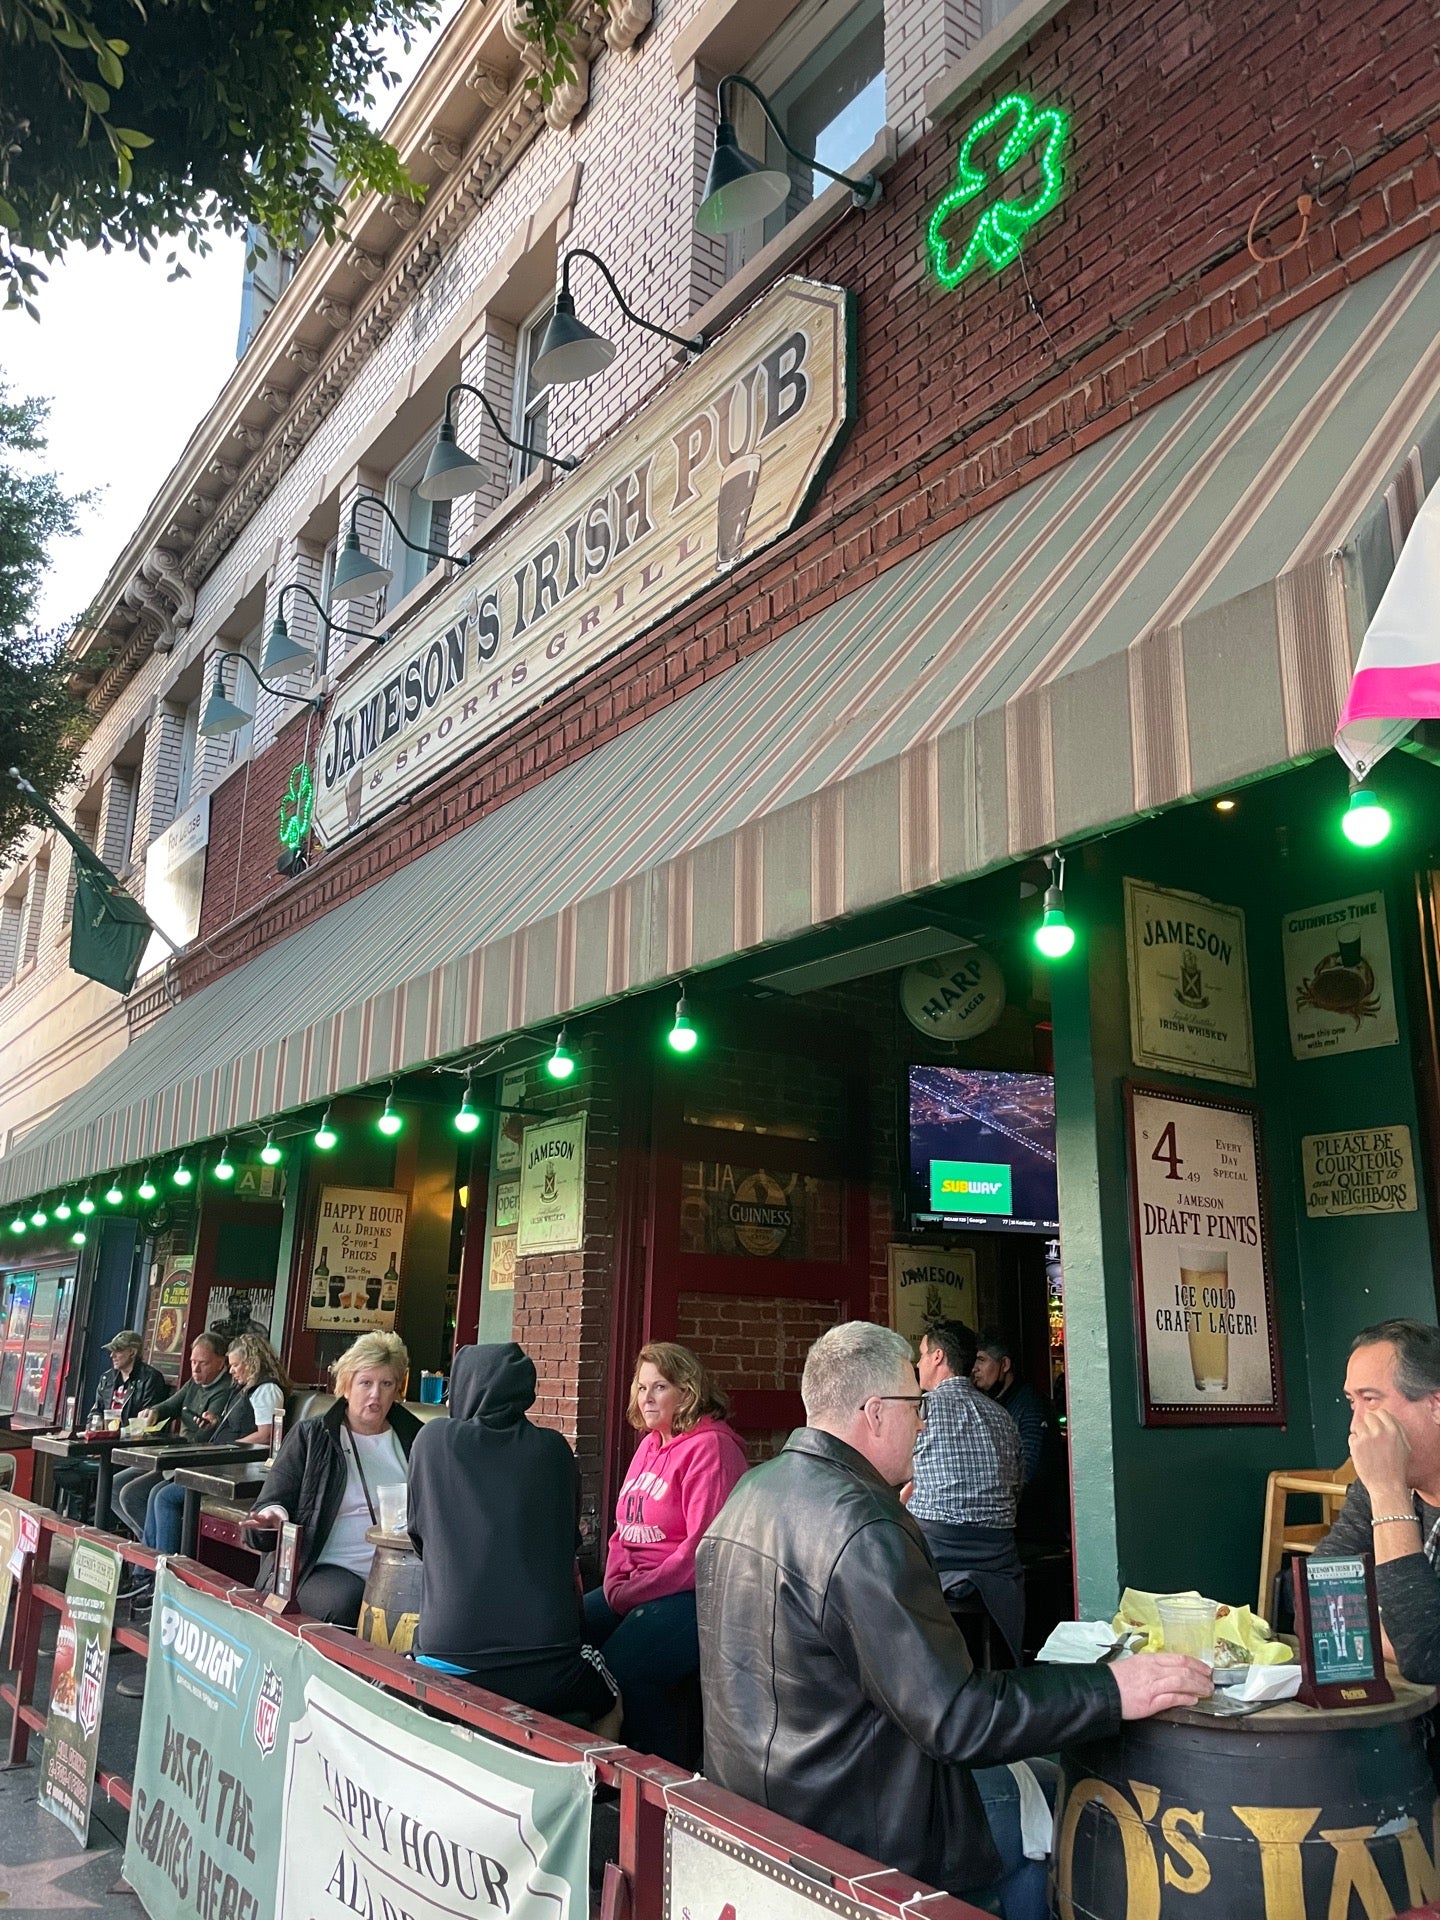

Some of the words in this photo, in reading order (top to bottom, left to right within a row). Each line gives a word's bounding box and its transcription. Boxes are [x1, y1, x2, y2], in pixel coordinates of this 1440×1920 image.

[325, 592, 501, 789] JAMESON'S
[512, 456, 655, 640] IRISH
[671, 332, 808, 515] PUB
[369, 770, 384, 790] &
[396, 659, 529, 772] SPORTS
[545, 534, 704, 661] GRILL
[1289, 908, 1346, 933] GUINNESS
[1348, 902, 1378, 919] TIME
[1143, 920, 1232, 966] JAMESON
[922, 960, 981, 1022] HARP
[959, 993, 986, 1019] LAGER
[1159, 1018, 1185, 1033] IRISH
[1187, 1026, 1228, 1042] WHISKEY
[1316, 1028, 1331, 1038] this
[1307, 1039, 1323, 1049] with
[528, 1141, 575, 1170] JAMESON
[1216, 1139, 1242, 1153] EVERY
[1313, 1135, 1368, 1157] PLEASE
[1373, 1133, 1393, 1152] BE
[1221, 1154, 1238, 1166] DAY
[1316, 1149, 1403, 1175] COURTEOUS
[240, 1171, 255, 1189] A
[941, 1180, 1002, 1194] SUBWAY
[1213, 1168, 1248, 1181] SPECIAL
[1312, 1174, 1335, 1188] and
[1338, 1170, 1384, 1189] QUIET
[1386, 1168, 1400, 1179] to
[1177, 1194, 1224, 1209] JAMESON
[1331, 1184, 1406, 1209] NEIGHBORS
[324, 1202, 366, 1220] HAPPY
[369, 1206, 403, 1224] HOUR
[729, 1203, 791, 1226] GUINNESS
[1143, 1203, 1200, 1235] DRAFT
[1206, 1215, 1257, 1247] PINTS
[332, 1222, 351, 1234] ALL
[355, 1223, 392, 1237] DRINKS
[341, 1235, 379, 1248] 2-FOR-1
[341, 1247, 377, 1260] PRICES
[1175, 1285, 1196, 1307] ICE
[1203, 1287, 1236, 1309] COLD
[1156, 1309, 1202, 1332] CRAFT
[1209, 1312, 1257, 1335] LAGER!
[626, 1495, 644, 1524] CA
[161, 1606, 199, 1661] BUD
[195, 1631, 243, 1694] LIGHT
[82, 1677, 98, 1722] NFL
[257, 1699, 276, 1743] NFL
[217, 1769, 255, 1864] THE
[135, 1788, 193, 1900] GAMES
[400, 1812, 511, 1914] HOUR
